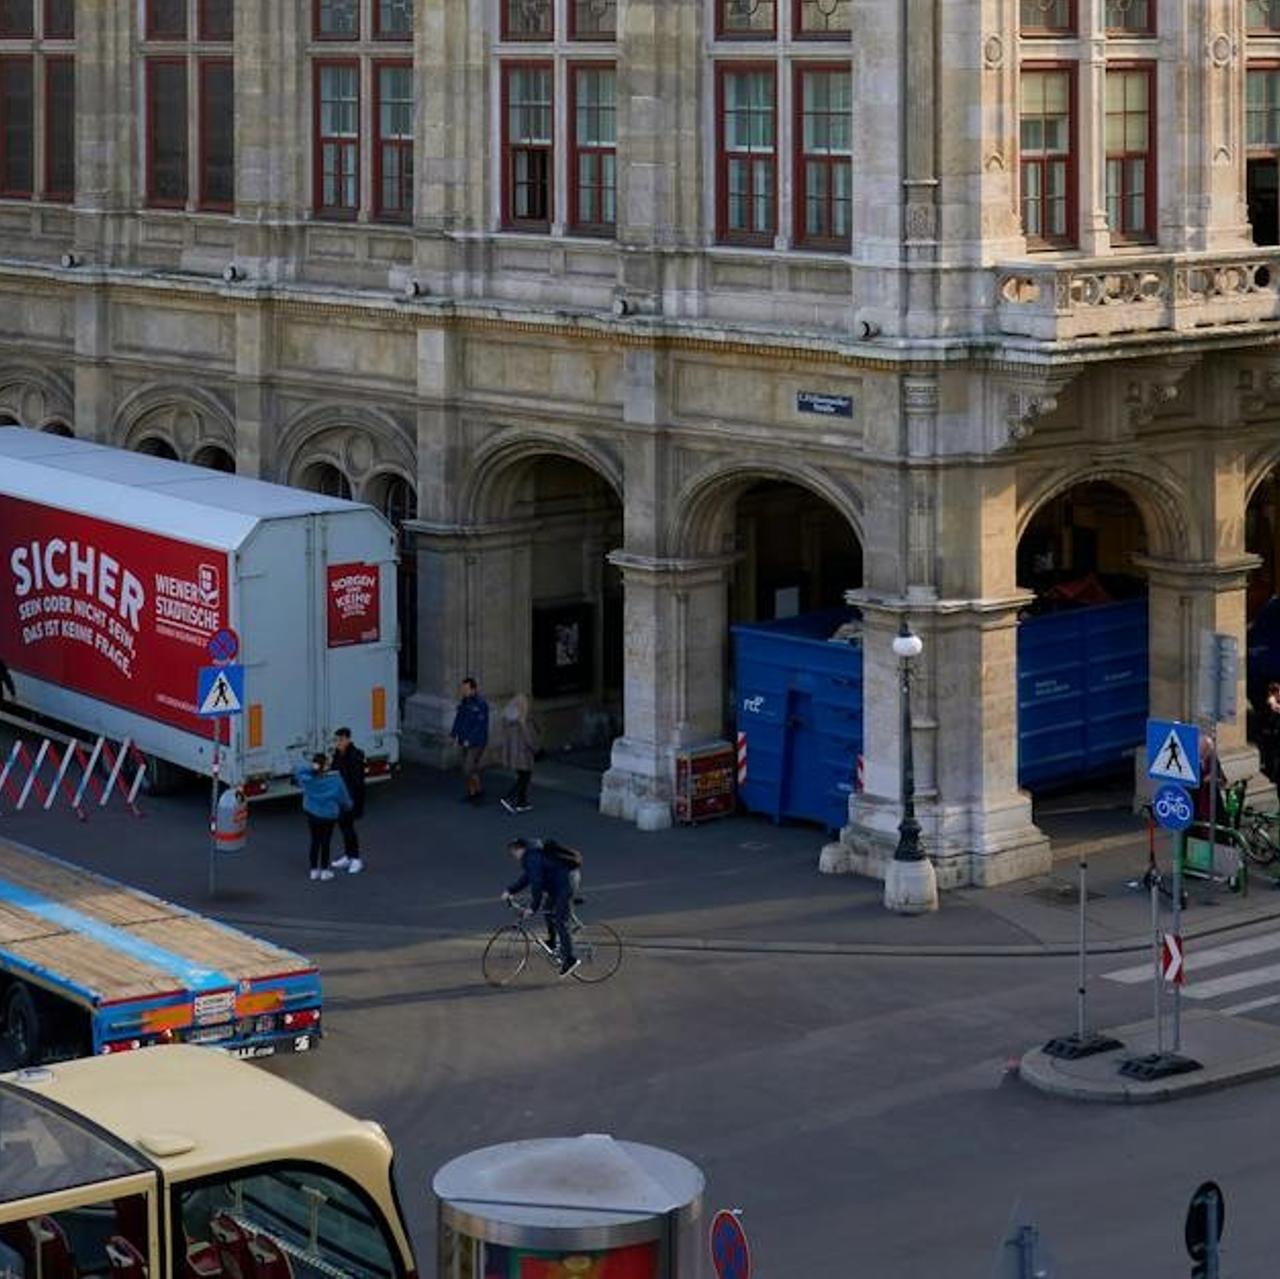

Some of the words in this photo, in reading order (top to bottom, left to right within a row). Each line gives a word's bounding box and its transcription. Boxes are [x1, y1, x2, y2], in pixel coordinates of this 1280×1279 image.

[10, 537, 145, 632] SICHER
[155, 573, 199, 603] WIENER
[19, 598, 42, 620] SEIN
[43, 595, 72, 614] ODER
[73, 599, 108, 628] NICHT
[108, 618, 136, 659] SEIN,
[23, 621, 44, 645] DAS
[44, 620, 59, 636] IST
[61, 620, 93, 645] KEINE
[95, 633, 132, 679] FRAGE.
